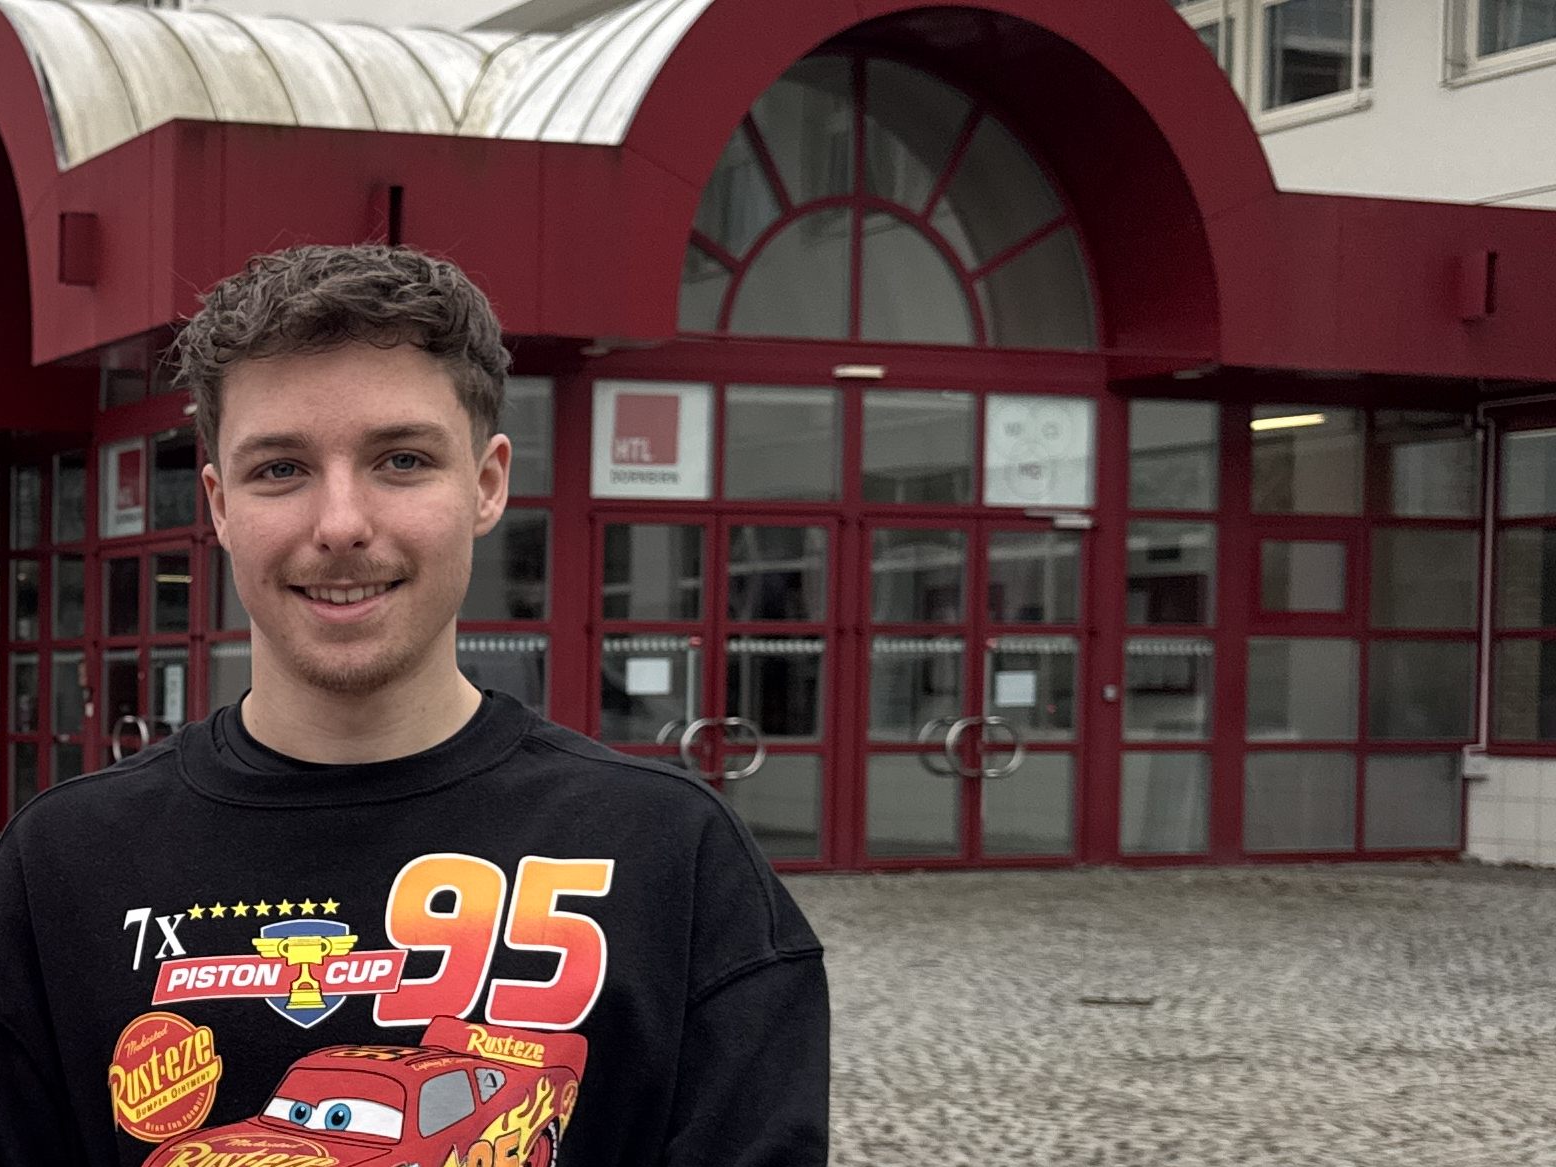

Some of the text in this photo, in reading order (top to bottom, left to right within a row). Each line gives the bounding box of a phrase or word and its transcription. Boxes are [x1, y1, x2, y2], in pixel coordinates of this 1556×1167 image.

[166, 959, 393, 992] PISTON CUP
[373, 853, 615, 1030] 95
